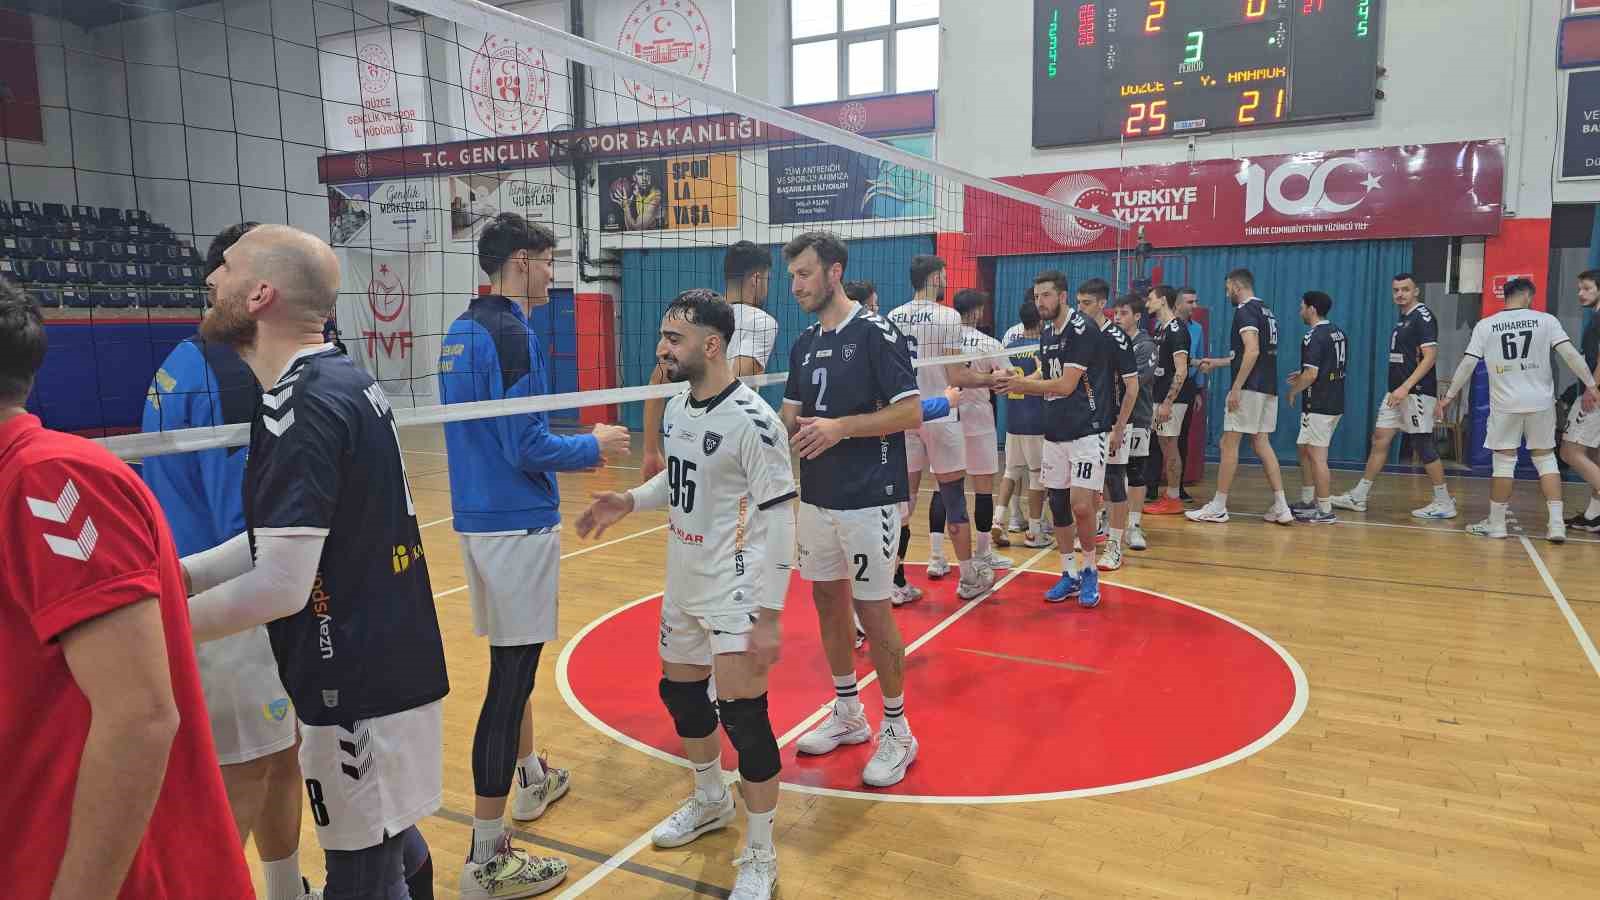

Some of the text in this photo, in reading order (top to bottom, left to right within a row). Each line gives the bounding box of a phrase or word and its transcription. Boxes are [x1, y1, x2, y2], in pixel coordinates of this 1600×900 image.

[1183, 31, 1204, 63] 3
[1126, 100, 1168, 134] 25
[1238, 89, 1284, 123] 21
[423, 151, 453, 168] T.C.
[1492, 319, 1539, 333] MUHARREM
[362, 330, 413, 360] TVF
[1501, 330, 1533, 360] 67
[812, 367, 827, 411] 2
[668, 455, 697, 514] 95
[1076, 461, 1092, 479] 18
[853, 553, 870, 581] 2
